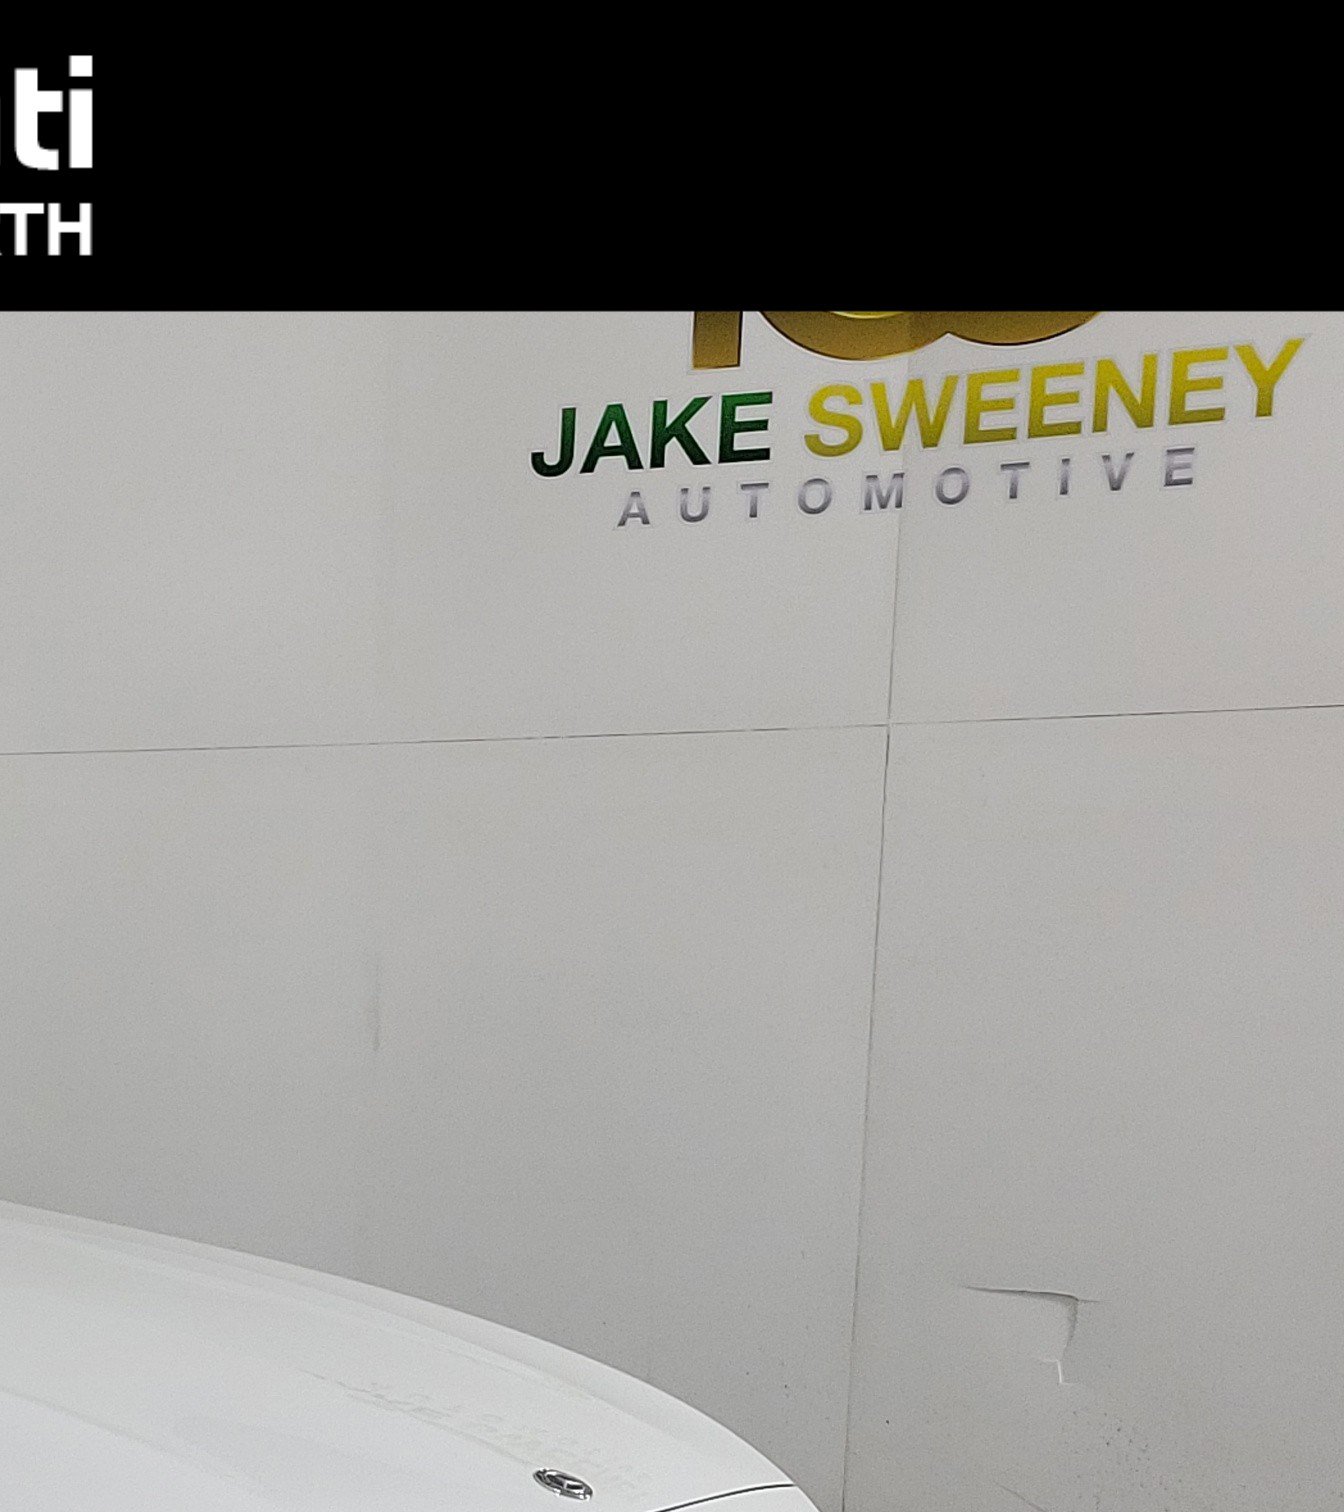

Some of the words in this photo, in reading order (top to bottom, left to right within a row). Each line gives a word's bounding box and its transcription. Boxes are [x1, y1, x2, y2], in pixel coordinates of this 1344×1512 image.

[530, 391, 774, 477] JAKE
[804, 338, 1303, 458] SWEENEY
[616, 446, 1196, 528] AUTOMOTIVE
